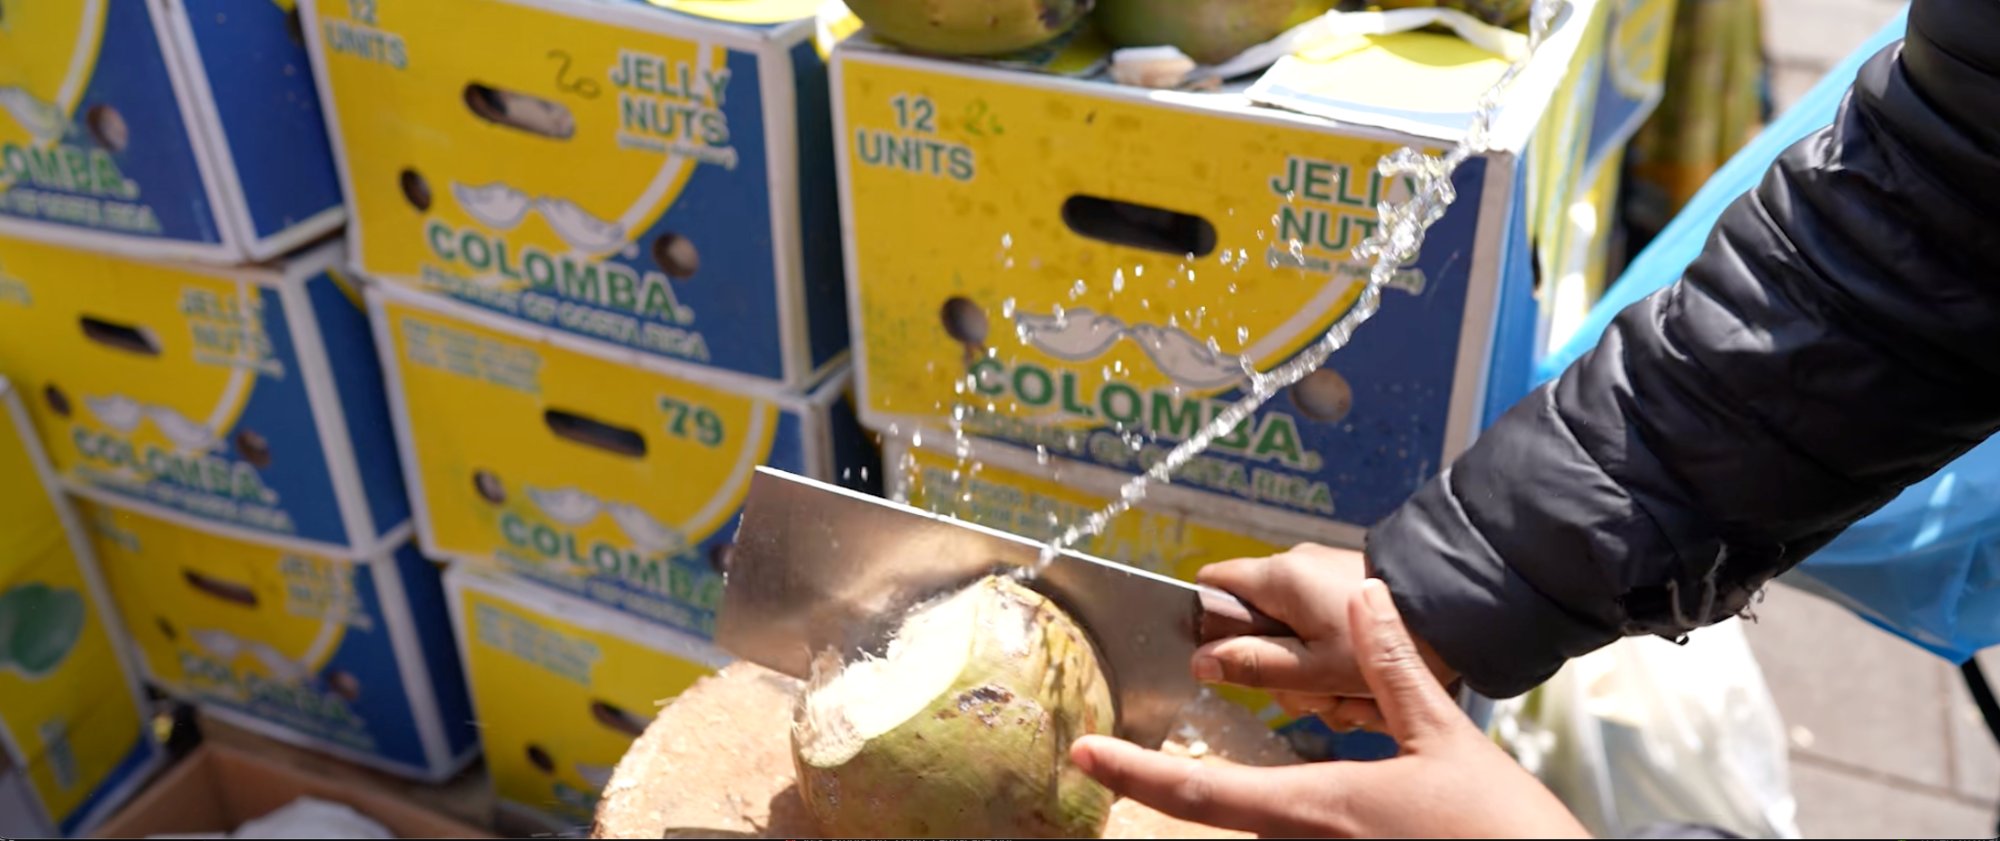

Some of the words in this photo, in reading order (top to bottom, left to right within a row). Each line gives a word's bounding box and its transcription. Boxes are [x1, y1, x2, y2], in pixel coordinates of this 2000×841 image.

[321, 17, 409, 71] UNITS
[610, 50, 731, 106] JELLY
[620, 93, 729, 147] NUTS
[892, 95, 935, 133] 12
[857, 129, 975, 182] UNITS
[660, 395, 724, 449] 79
[1253, 466, 1336, 515] RICA
